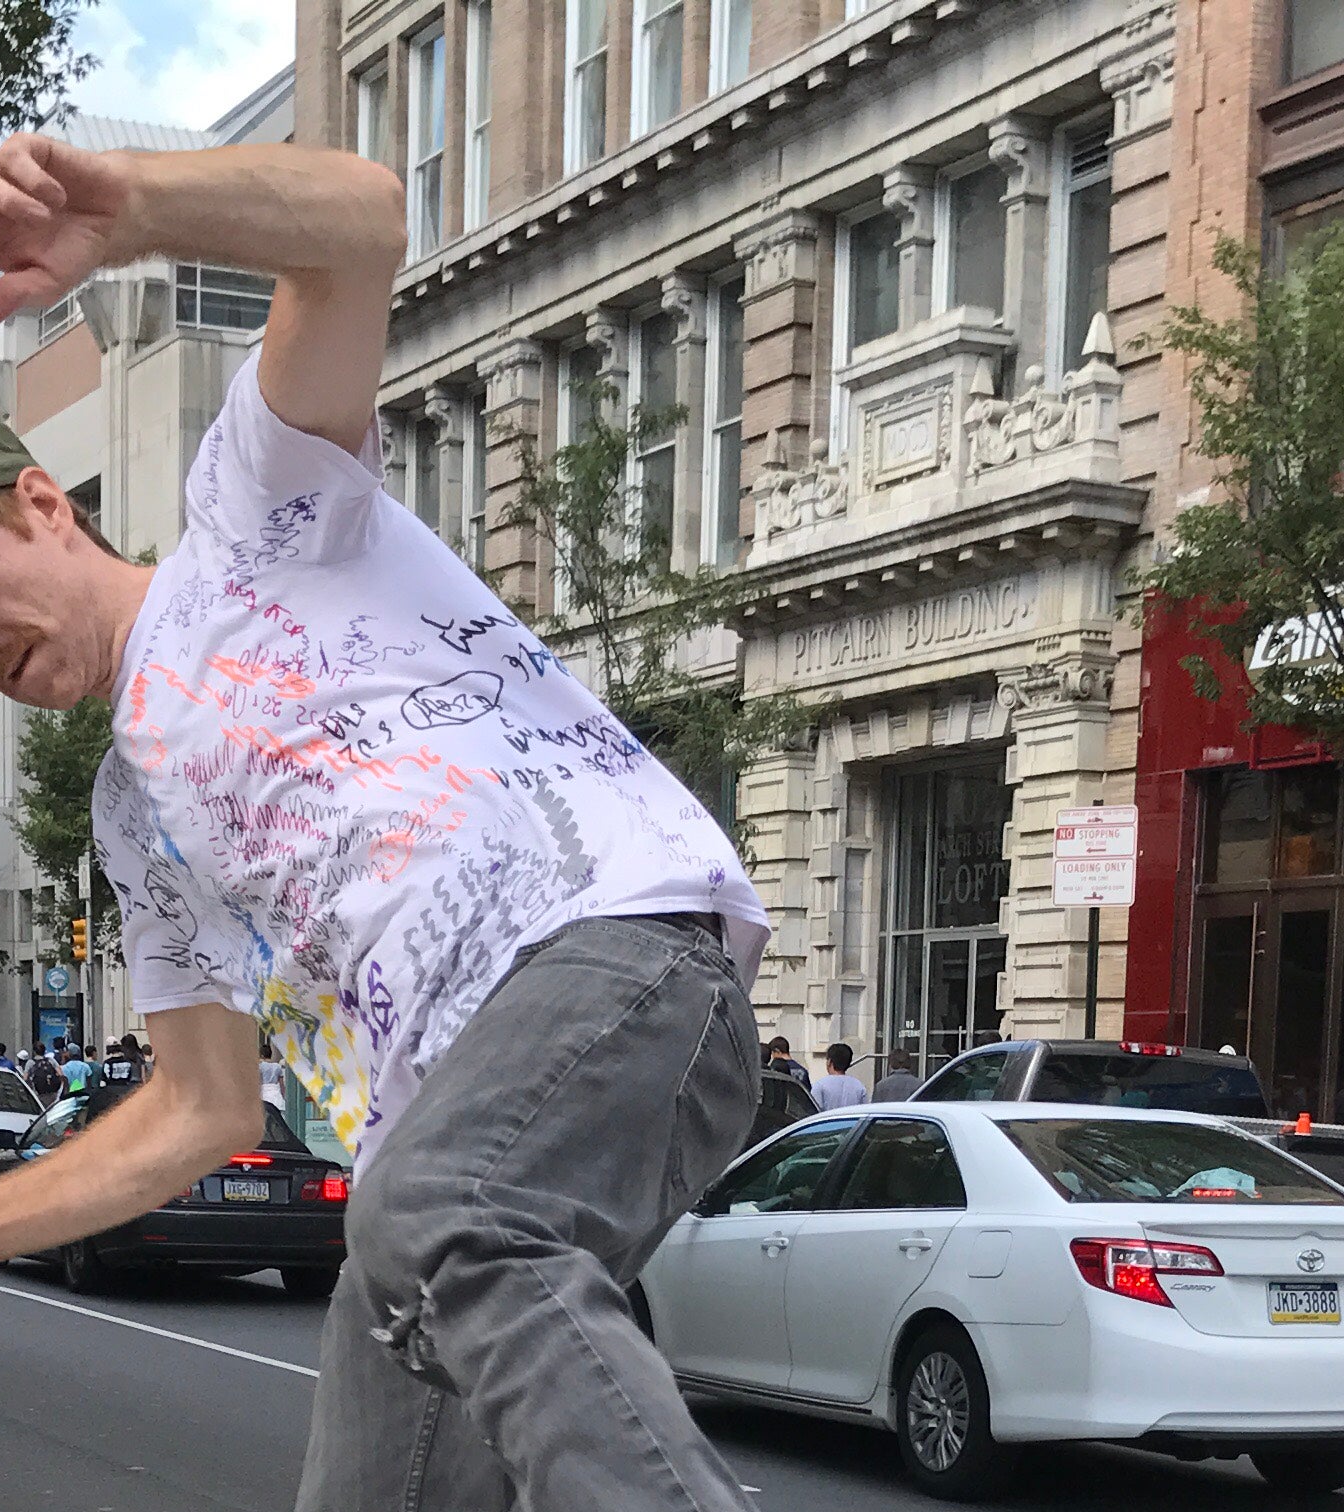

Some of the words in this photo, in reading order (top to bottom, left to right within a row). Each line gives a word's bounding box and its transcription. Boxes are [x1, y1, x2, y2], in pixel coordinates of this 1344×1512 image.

[792, 607, 893, 676] PITCAIRN
[1059, 828, 1074, 839] NO
[1078, 828, 1121, 840] STOPPING
[1062, 863, 1101, 874] LOADING
[1104, 862, 1127, 873] ONLY
[937, 862, 1005, 904] LOFT
